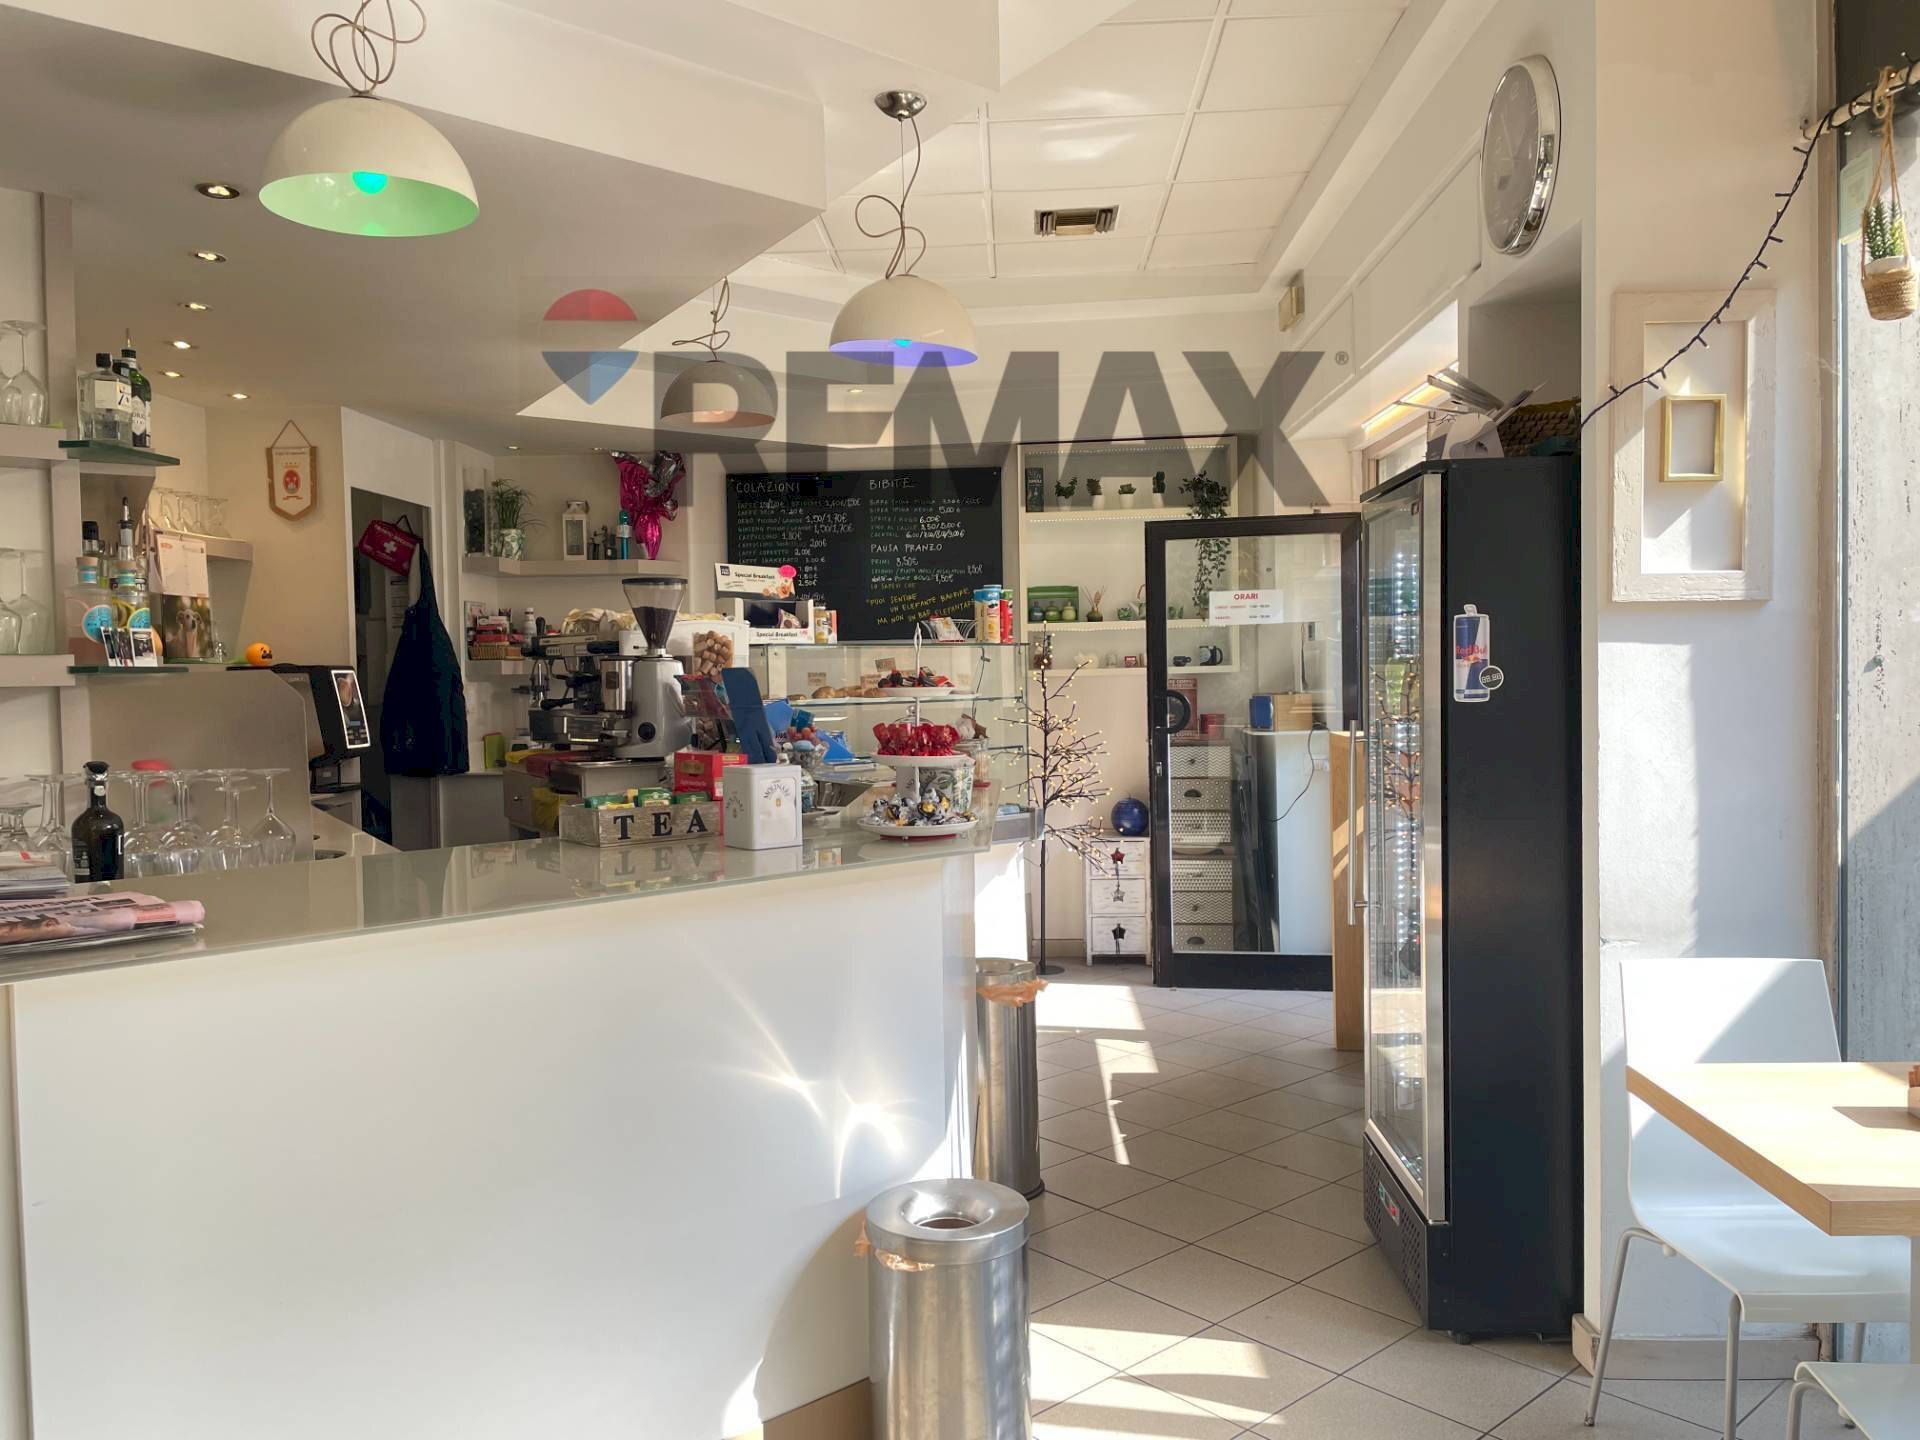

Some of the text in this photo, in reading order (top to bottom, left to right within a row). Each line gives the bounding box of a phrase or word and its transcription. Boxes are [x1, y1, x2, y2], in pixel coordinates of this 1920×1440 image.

[736, 480, 801, 494] COLAZIONI
[869, 477, 916, 490] BIBITE
[870, 543, 943, 553] PAUSA PRANZO
[890, 592, 918, 604] SENTIRE
[902, 596, 937, 610] ELEFANTE
[877, 617, 888, 625] MA
[891, 614, 904, 624] NON
[918, 609, 931, 618] BAR
[613, 808, 708, 840] TEA
